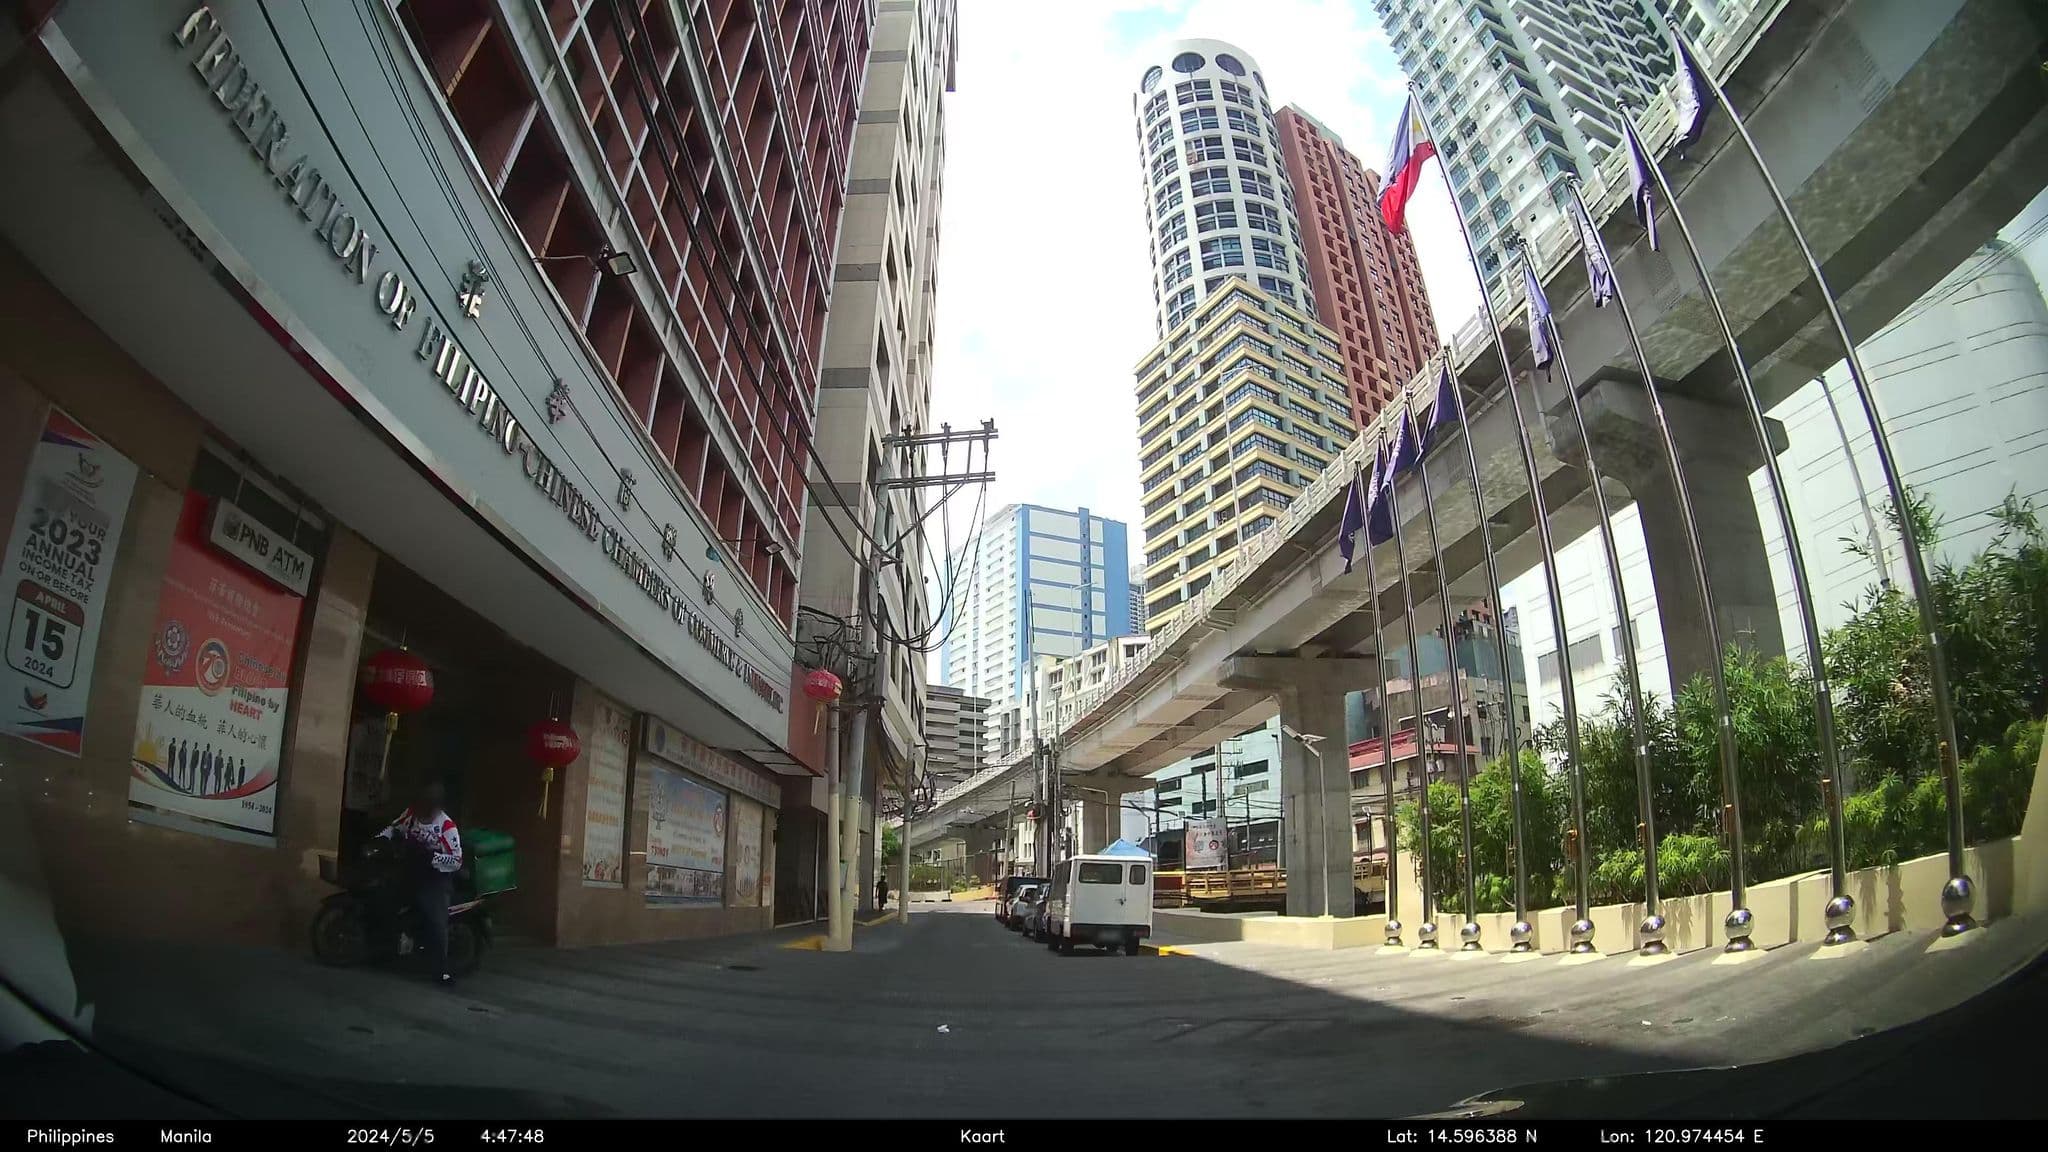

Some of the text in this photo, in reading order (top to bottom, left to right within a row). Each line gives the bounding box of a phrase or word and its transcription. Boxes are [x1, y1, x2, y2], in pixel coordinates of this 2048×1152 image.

[172, 6, 379, 284] FEDERATION
[377, 270, 416, 331] OF
[25, 533, 96, 582] ANNUAL
[29, 506, 103, 566] 2023
[238, 523, 305, 580] PNB ATM
[19, 561, 89, 604] ON OR BEFORE
[22, 546, 93, 593] INCOME TAX
[34, 591, 66, 614] APRIL
[25, 608, 66, 660] 15
[24, 656, 54, 678] 2024
[229, 699, 263, 721] HEART
[231, 685, 280, 713] Filipino by
